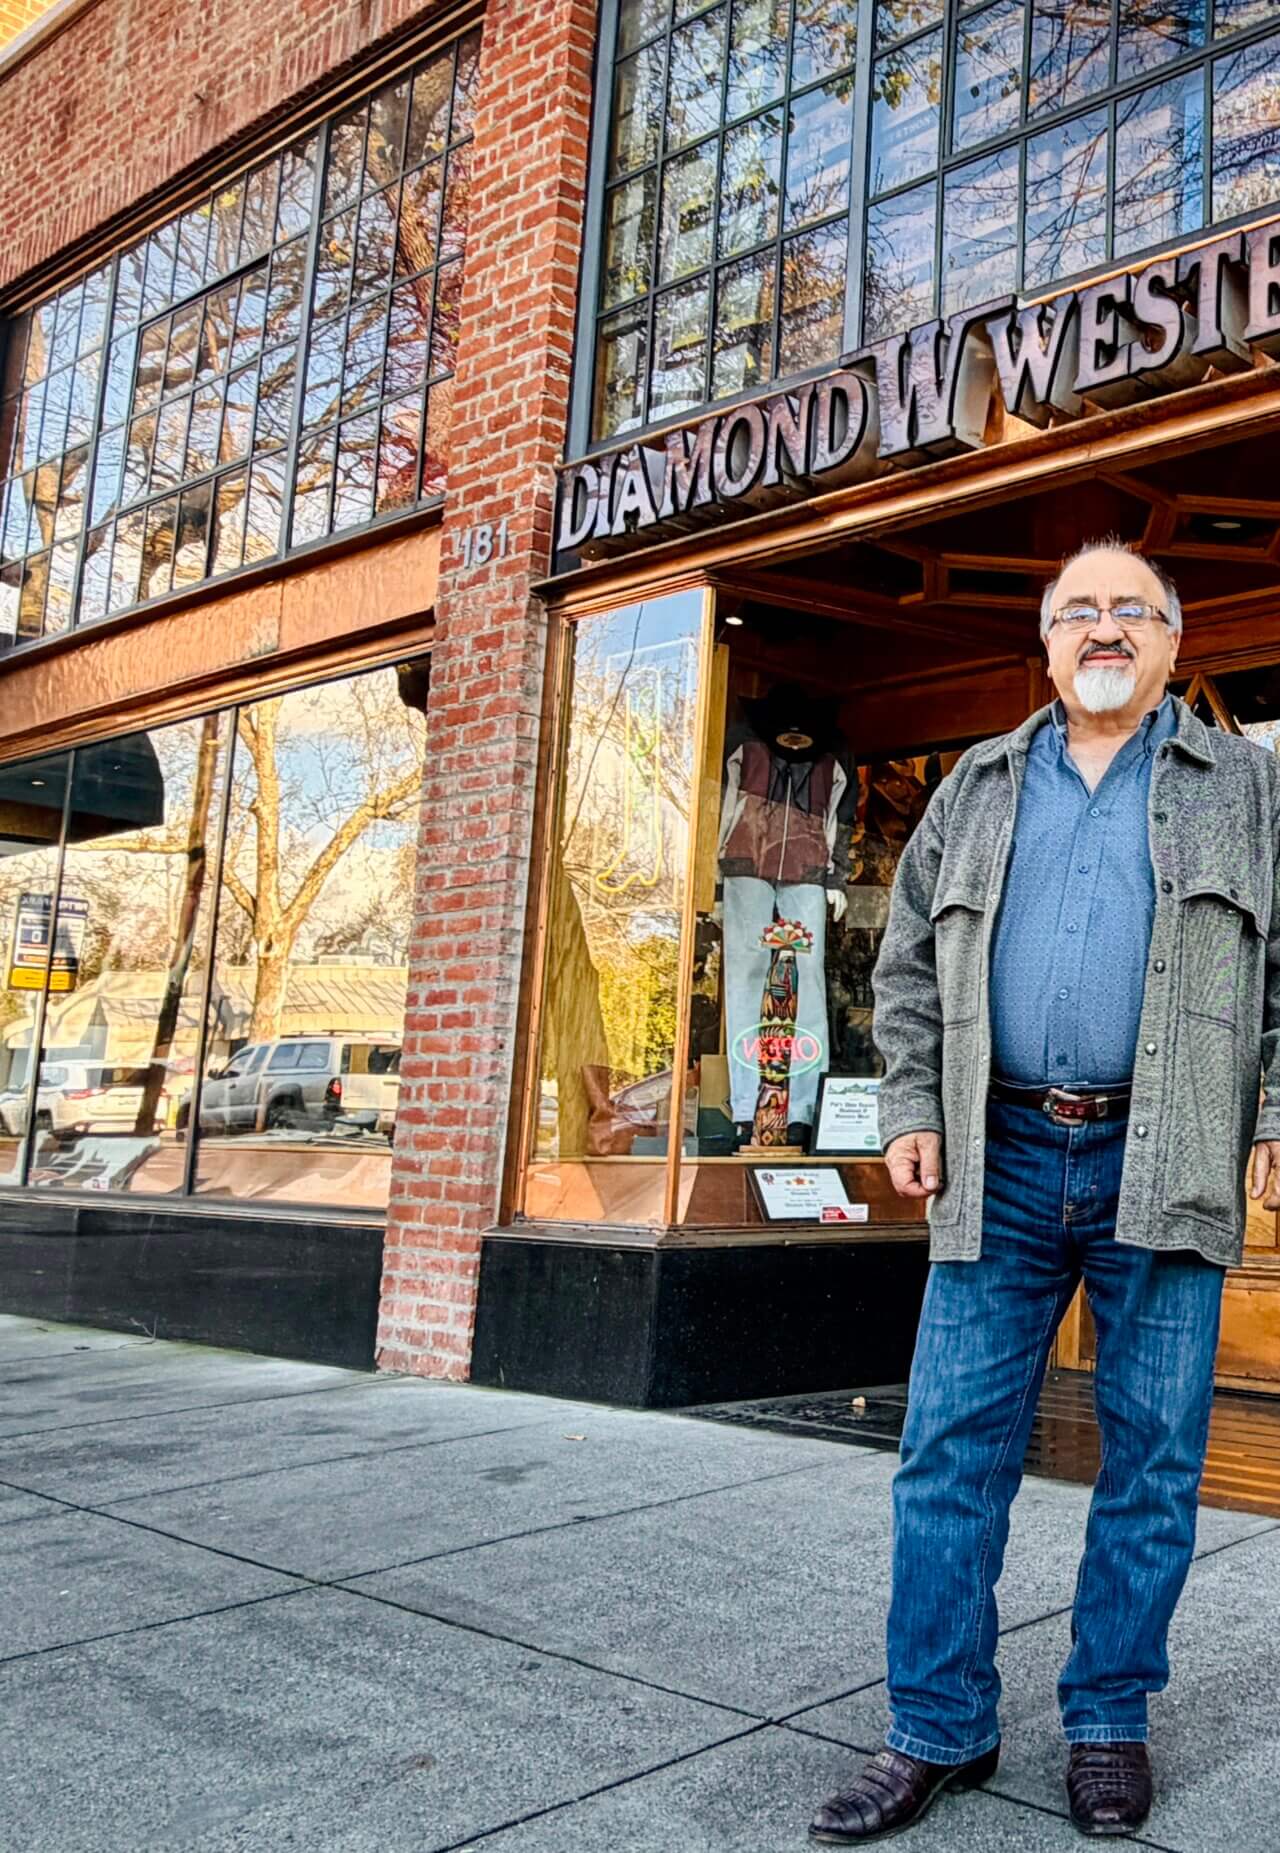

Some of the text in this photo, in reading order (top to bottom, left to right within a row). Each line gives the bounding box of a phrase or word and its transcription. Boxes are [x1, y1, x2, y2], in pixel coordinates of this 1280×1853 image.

[556, 374, 869, 552] DIAMOND
[839, 294, 1018, 458] W
[459, 517, 508, 569] 181
